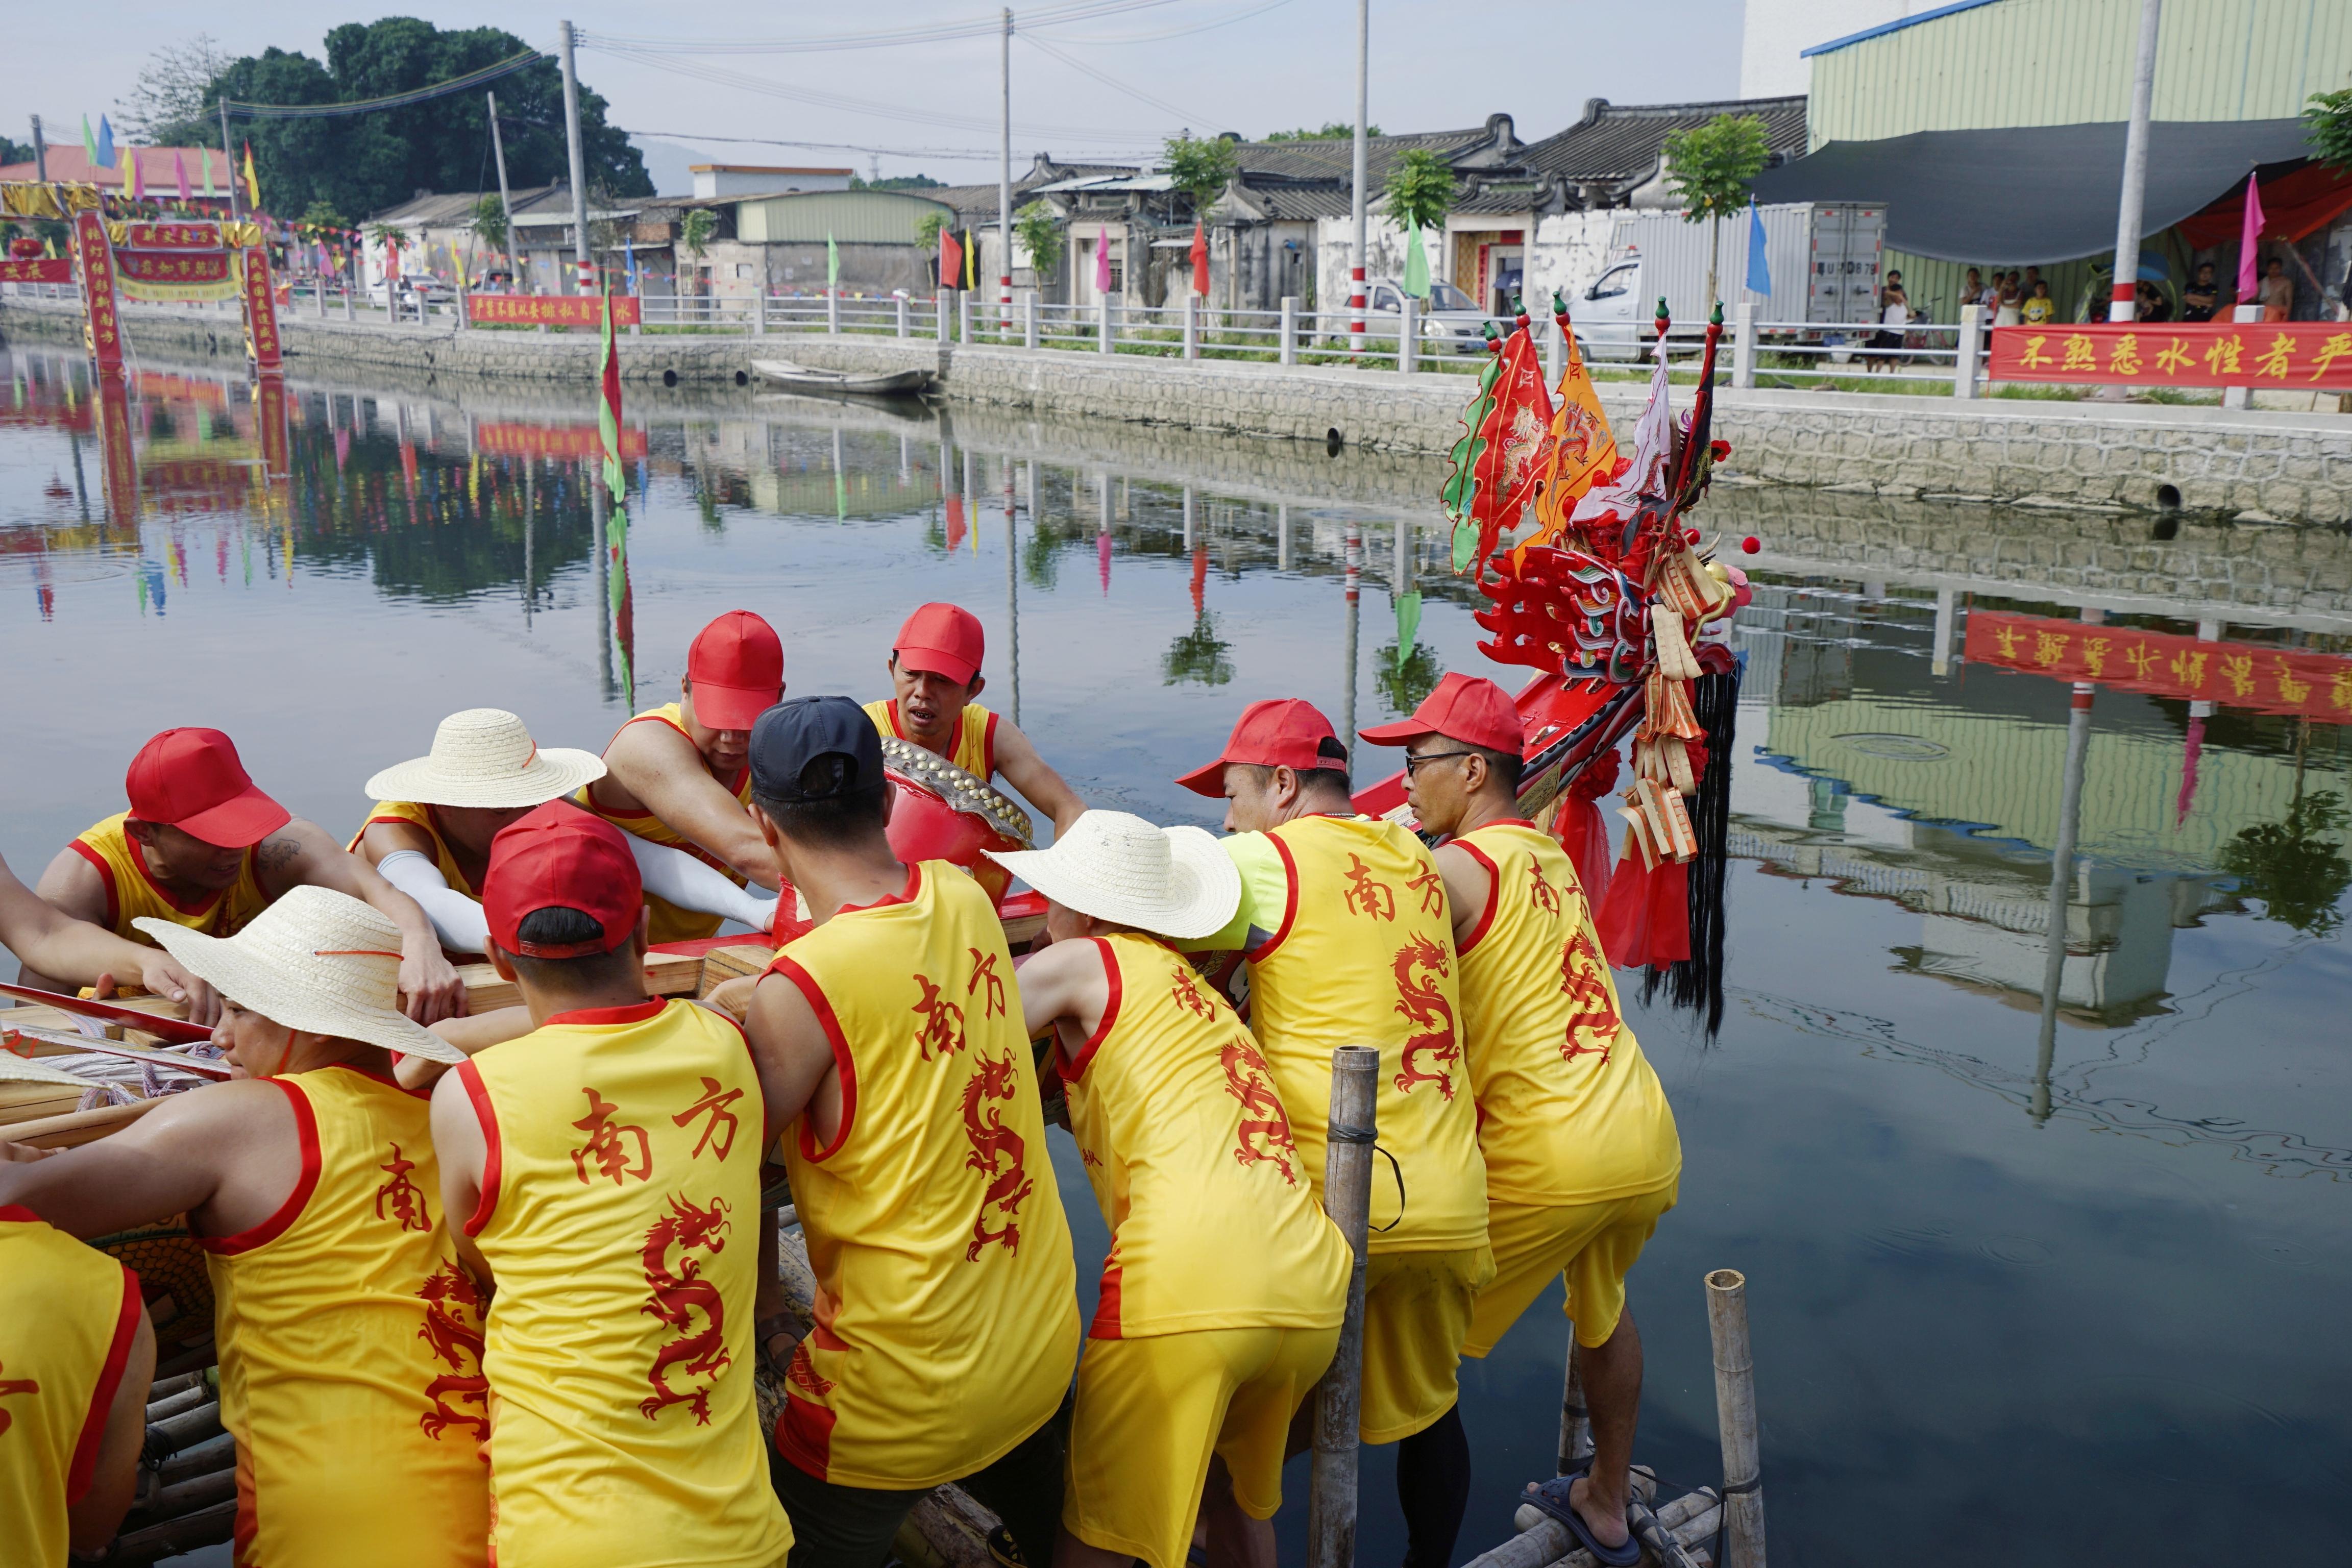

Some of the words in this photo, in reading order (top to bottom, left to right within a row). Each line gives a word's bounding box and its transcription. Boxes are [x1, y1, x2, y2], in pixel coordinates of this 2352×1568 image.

[2019, 332, 2352, 382] 不熟悉水性者严
[1343, 852, 1443, 922] 南方
[1527, 851, 1589, 923] 南方
[911, 947, 1006, 1062] 南方
[1171, 964, 1244, 1024] 南
[571, 1076, 744, 1186] 南方
[376, 1141, 433, 1233] 南
